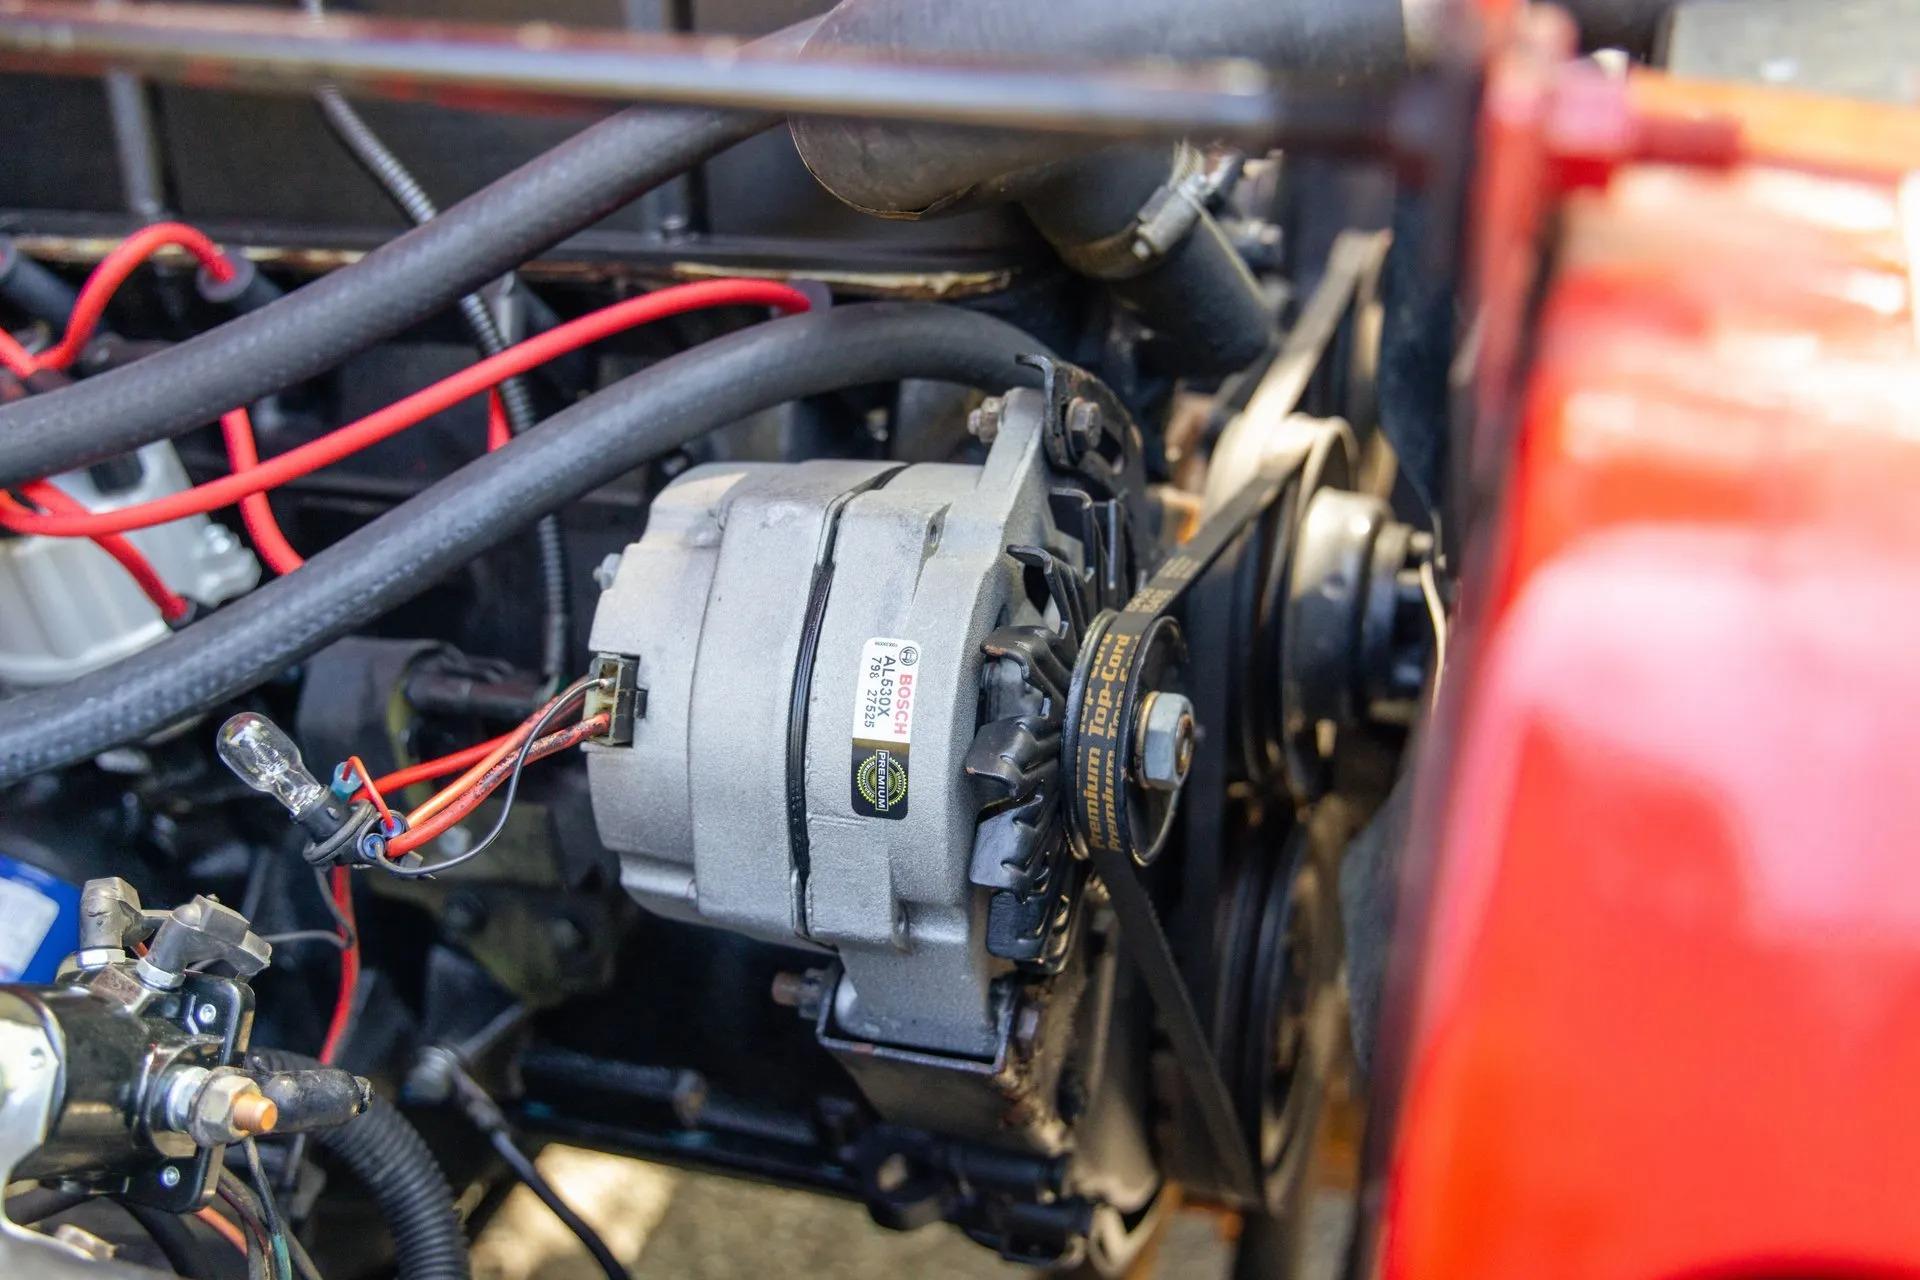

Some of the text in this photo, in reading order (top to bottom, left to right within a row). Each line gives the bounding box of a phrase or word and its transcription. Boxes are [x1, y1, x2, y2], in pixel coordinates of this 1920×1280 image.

[864, 657, 882, 728] 798 27525
[877, 655, 896, 717] AL530X
[894, 674, 912, 735] BOSCH
[1083, 634, 1131, 848] Premium Top-Cord
[877, 752, 887, 809] PREMIUM
